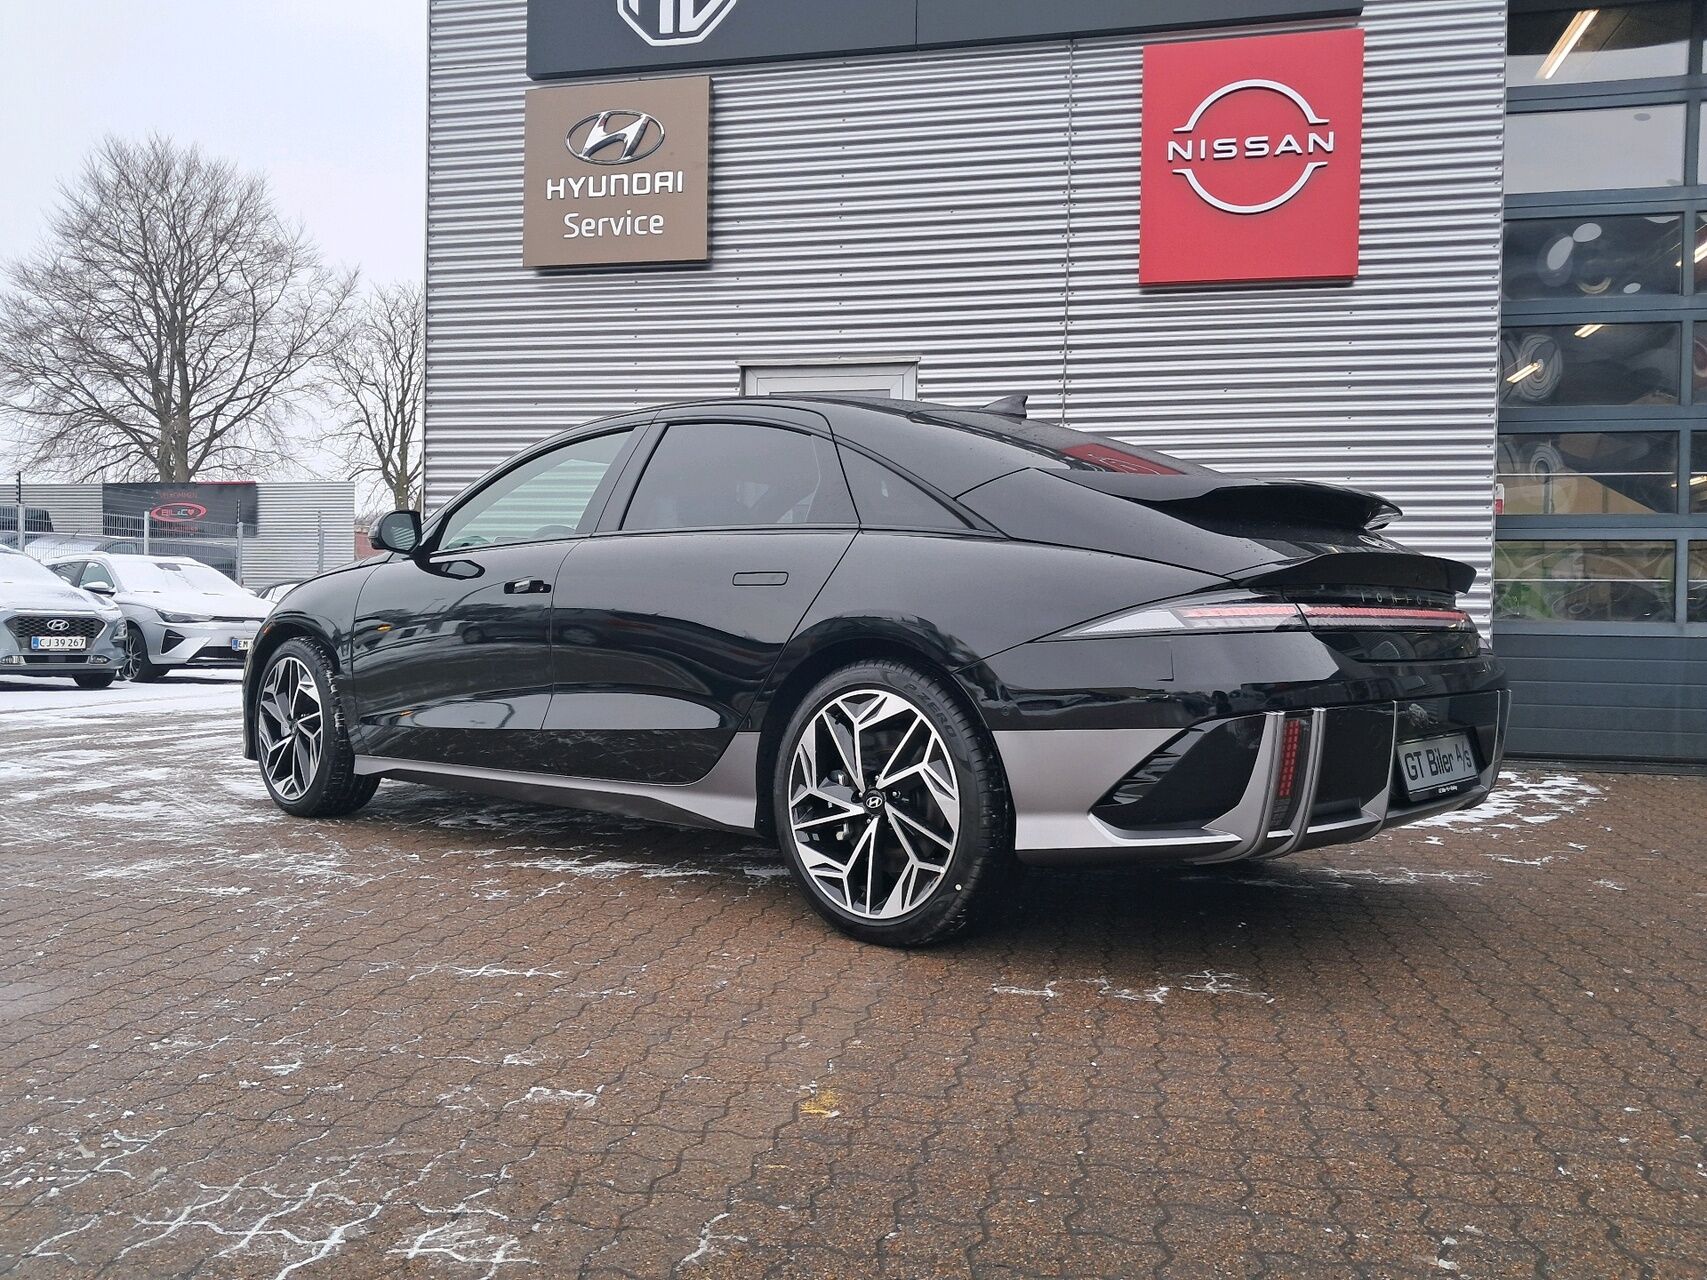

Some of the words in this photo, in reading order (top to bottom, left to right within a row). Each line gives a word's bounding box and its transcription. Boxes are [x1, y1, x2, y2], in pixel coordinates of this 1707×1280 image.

[1167, 131, 1335, 161] NISSAN
[546, 170, 683, 200] HYUNDAI
[563, 210, 664, 238] Service
[40, 639, 51, 647] CJ
[54, 639, 66, 647] 39
[68, 639, 85, 647] 267
[1404, 751, 1424, 780] GT
[1426, 748, 1454, 776] Biler
